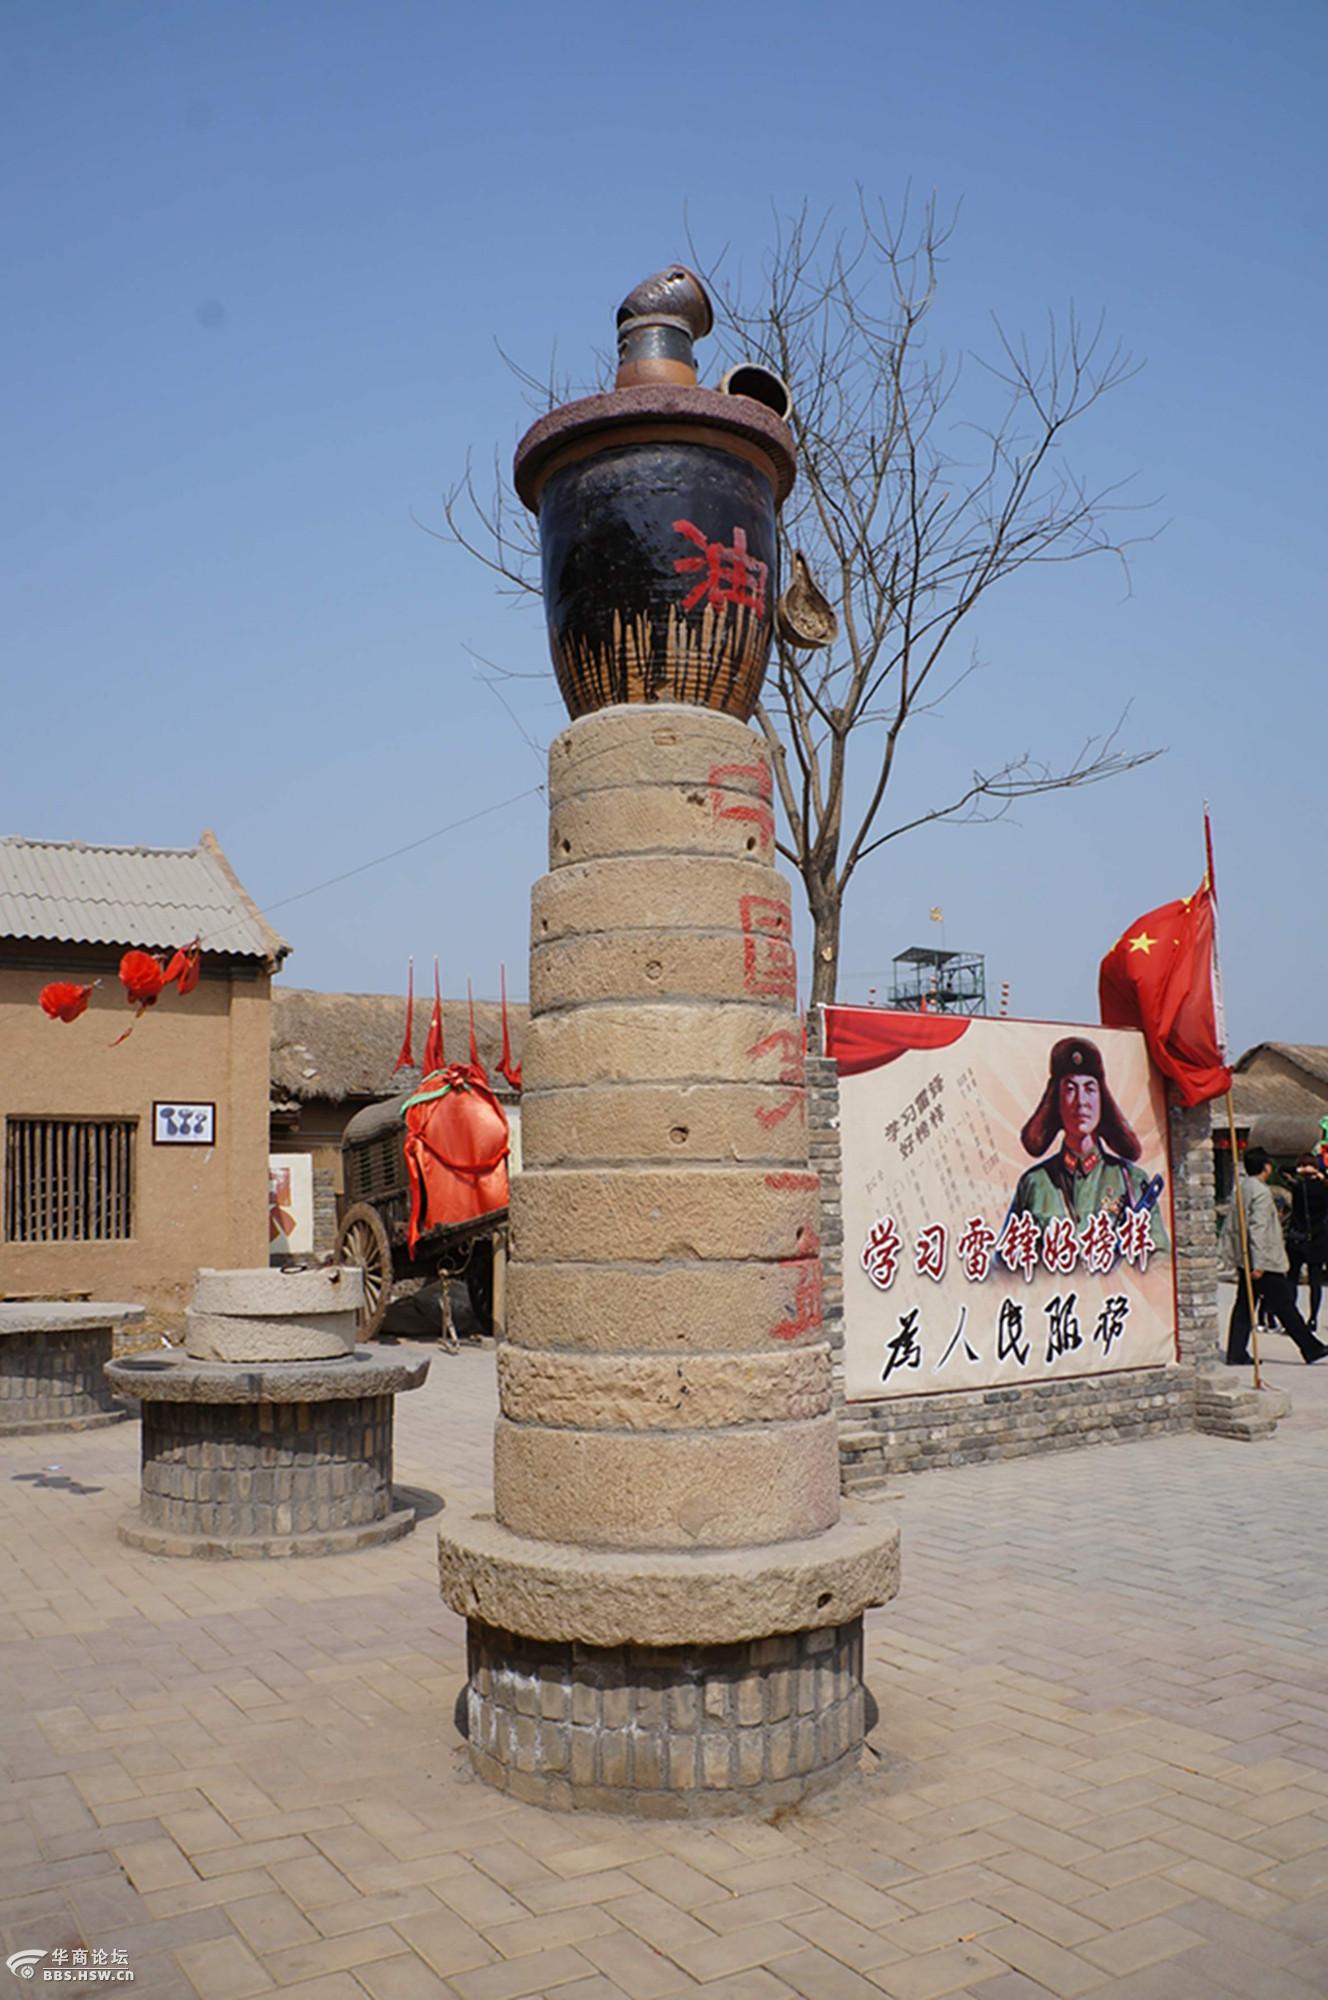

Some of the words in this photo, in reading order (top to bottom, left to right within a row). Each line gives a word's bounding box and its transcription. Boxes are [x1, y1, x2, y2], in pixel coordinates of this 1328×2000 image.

[672, 519, 768, 620] 油
[884, 1073, 945, 1143] 学习雷锋
[898, 1103, 946, 1161] 好榜样
[862, 1210, 1155, 1288] 学习雷锋好榜样
